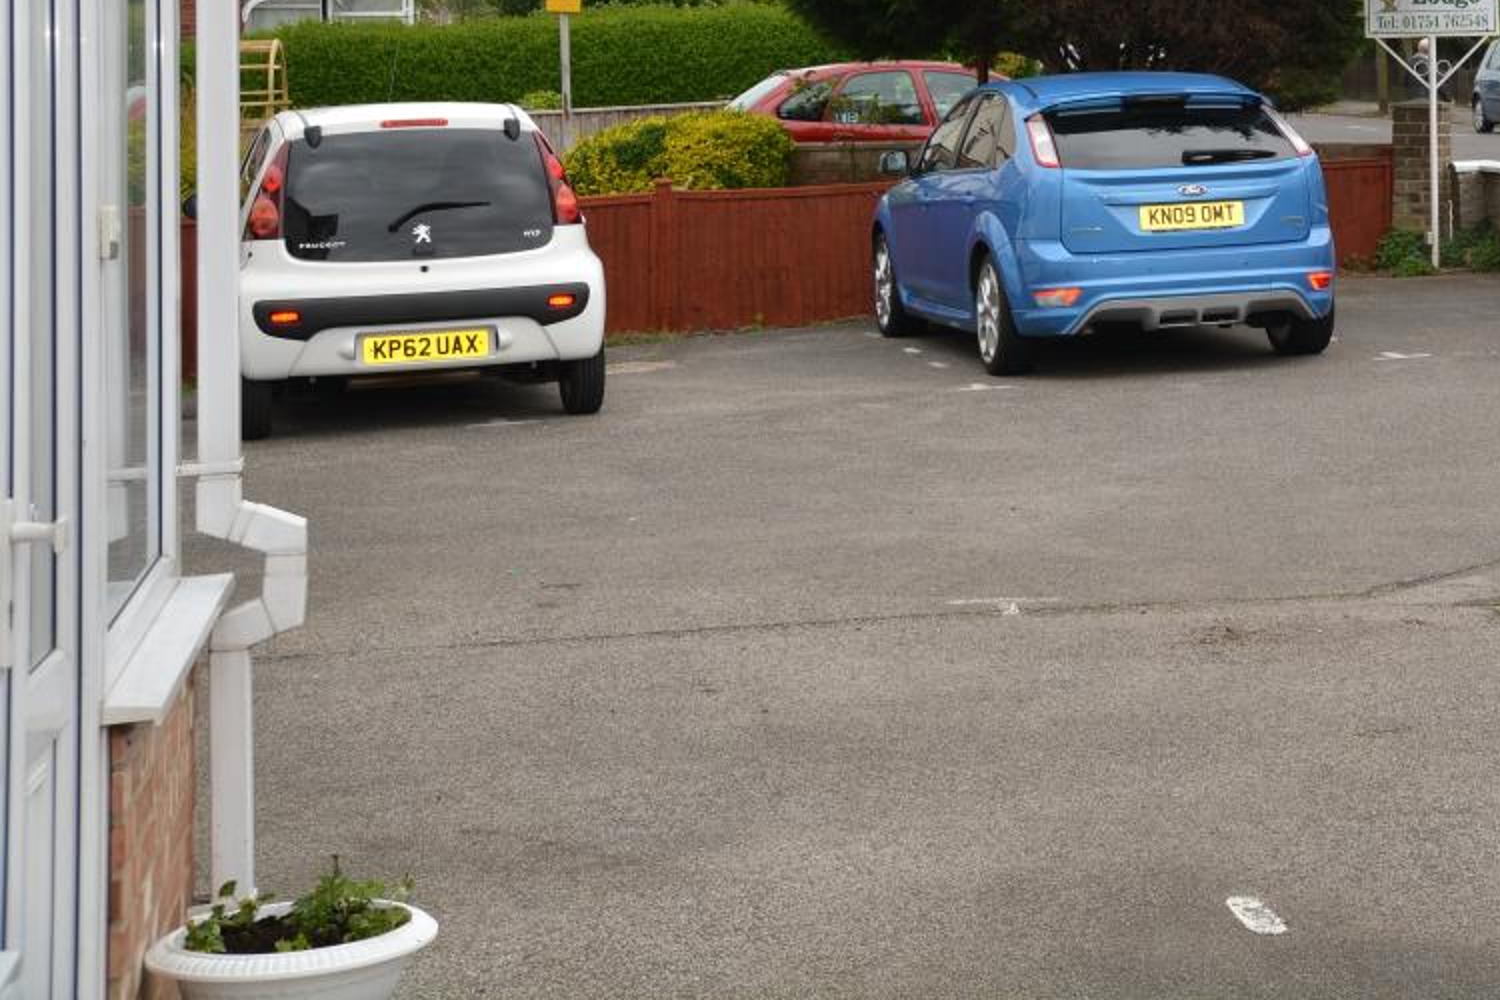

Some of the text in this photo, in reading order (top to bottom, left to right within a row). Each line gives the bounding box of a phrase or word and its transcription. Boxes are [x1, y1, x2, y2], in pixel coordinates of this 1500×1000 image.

[1148, 206, 1196, 225] KN09
[373, 333, 479, 359] KP62 UAX
